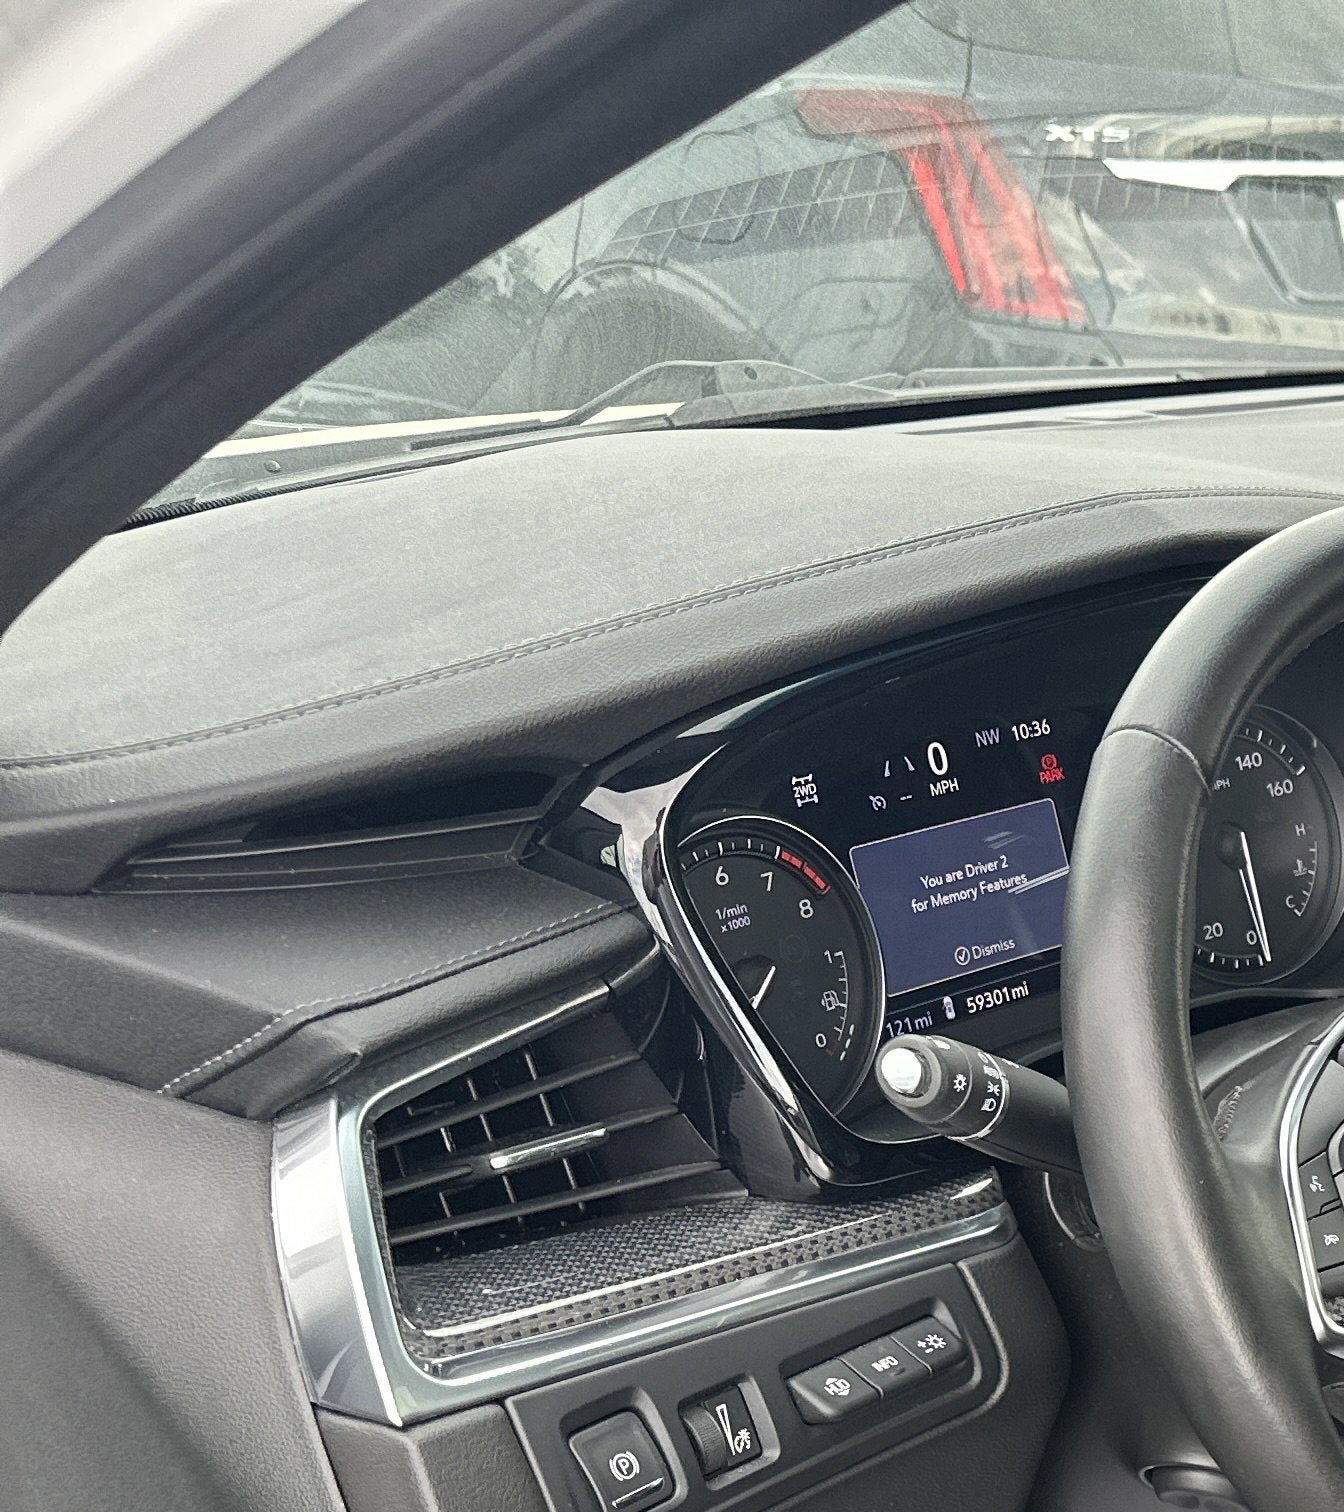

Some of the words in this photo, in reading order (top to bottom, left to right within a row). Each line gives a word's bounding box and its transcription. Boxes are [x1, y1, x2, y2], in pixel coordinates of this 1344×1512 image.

[974, 728, 1000, 748] NW
[1011, 718, 1051, 742] 10:36
[927, 741, 949, 776] 0
[1235, 752, 1263, 771] 140
[793, 783, 817, 798] 2WD
[929, 777, 960, 797] MPH
[1266, 778, 1294, 798] 160
[715, 866, 730, 886] 6
[760, 871, 773, 892] 7
[919, 875, 944, 889] You
[945, 870, 965, 883] are
[965, 860, 999, 878] Driver
[1000, 855, 1009, 869] 2
[911, 898, 929, 914] for
[930, 888, 978, 908] Memory
[979, 873, 1029, 895] Features
[714, 903, 749, 920] 1/min
[799, 899, 815, 919] 8
[721, 916, 751, 933] x1000
[1203, 922, 1224, 941] 20
[1246, 930, 1258, 946] 0
[971, 938, 1016, 960] Dismiss
[871, 1355, 899, 1372] INFO
[823, 1378, 851, 1396] HUD
